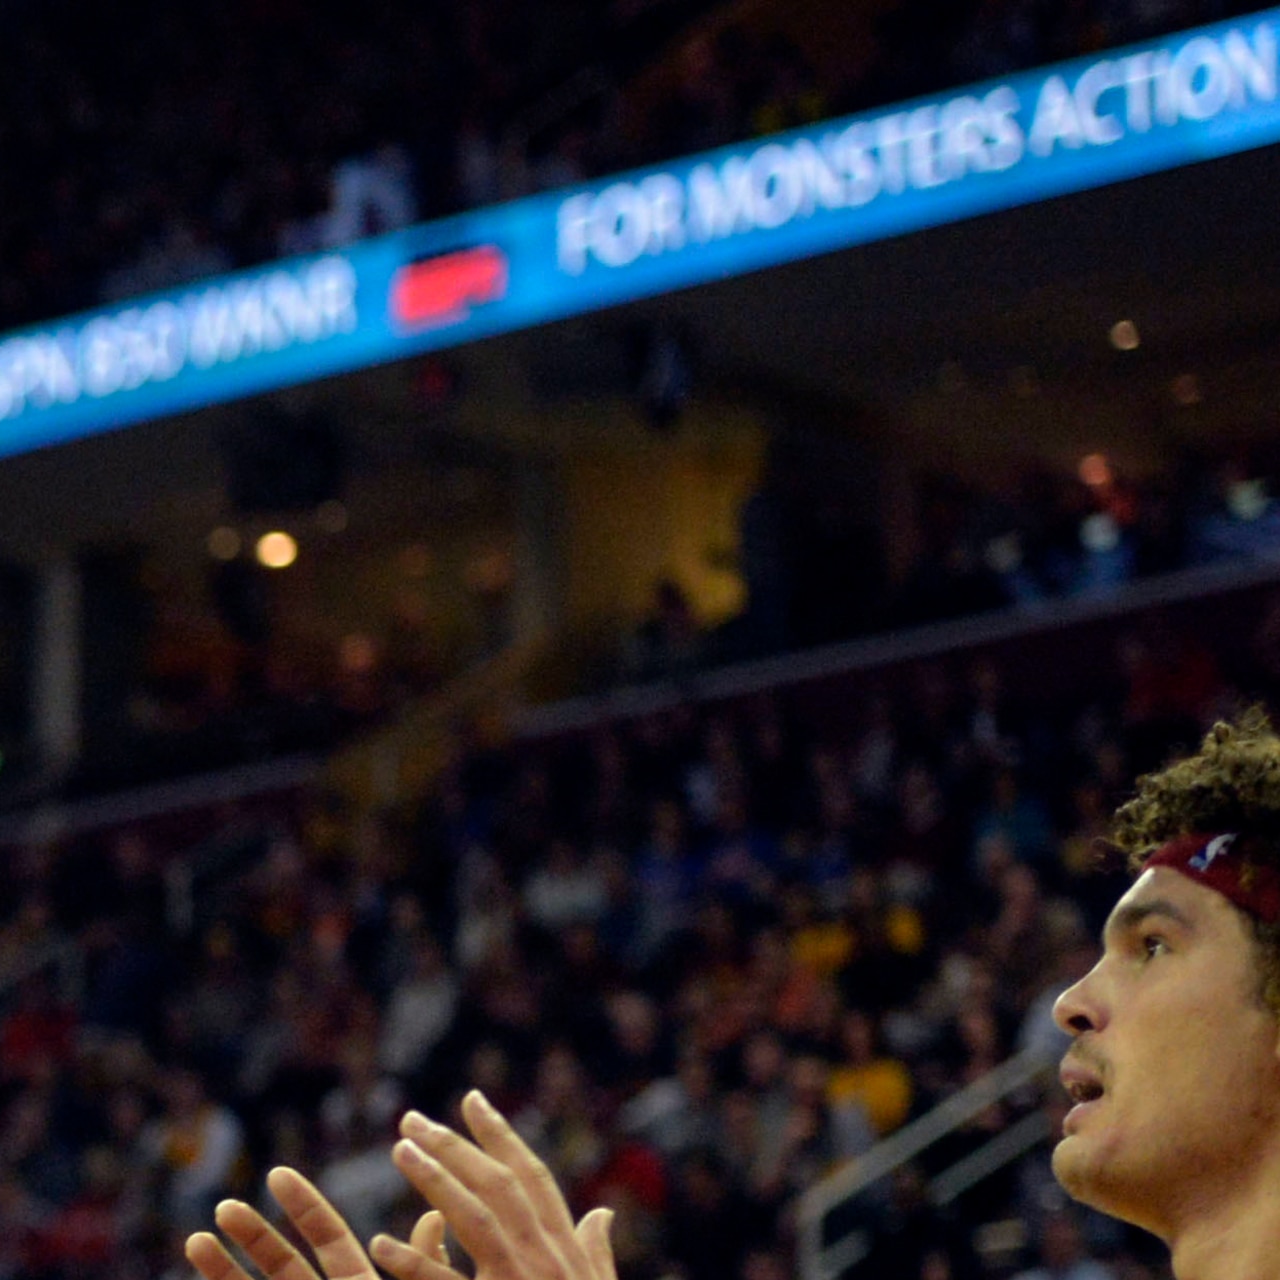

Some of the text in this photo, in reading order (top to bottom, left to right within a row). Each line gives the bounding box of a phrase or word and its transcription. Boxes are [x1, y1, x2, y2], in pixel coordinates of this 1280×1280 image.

[556, 20, 1278, 276] FOR MONSTERS ACTION
